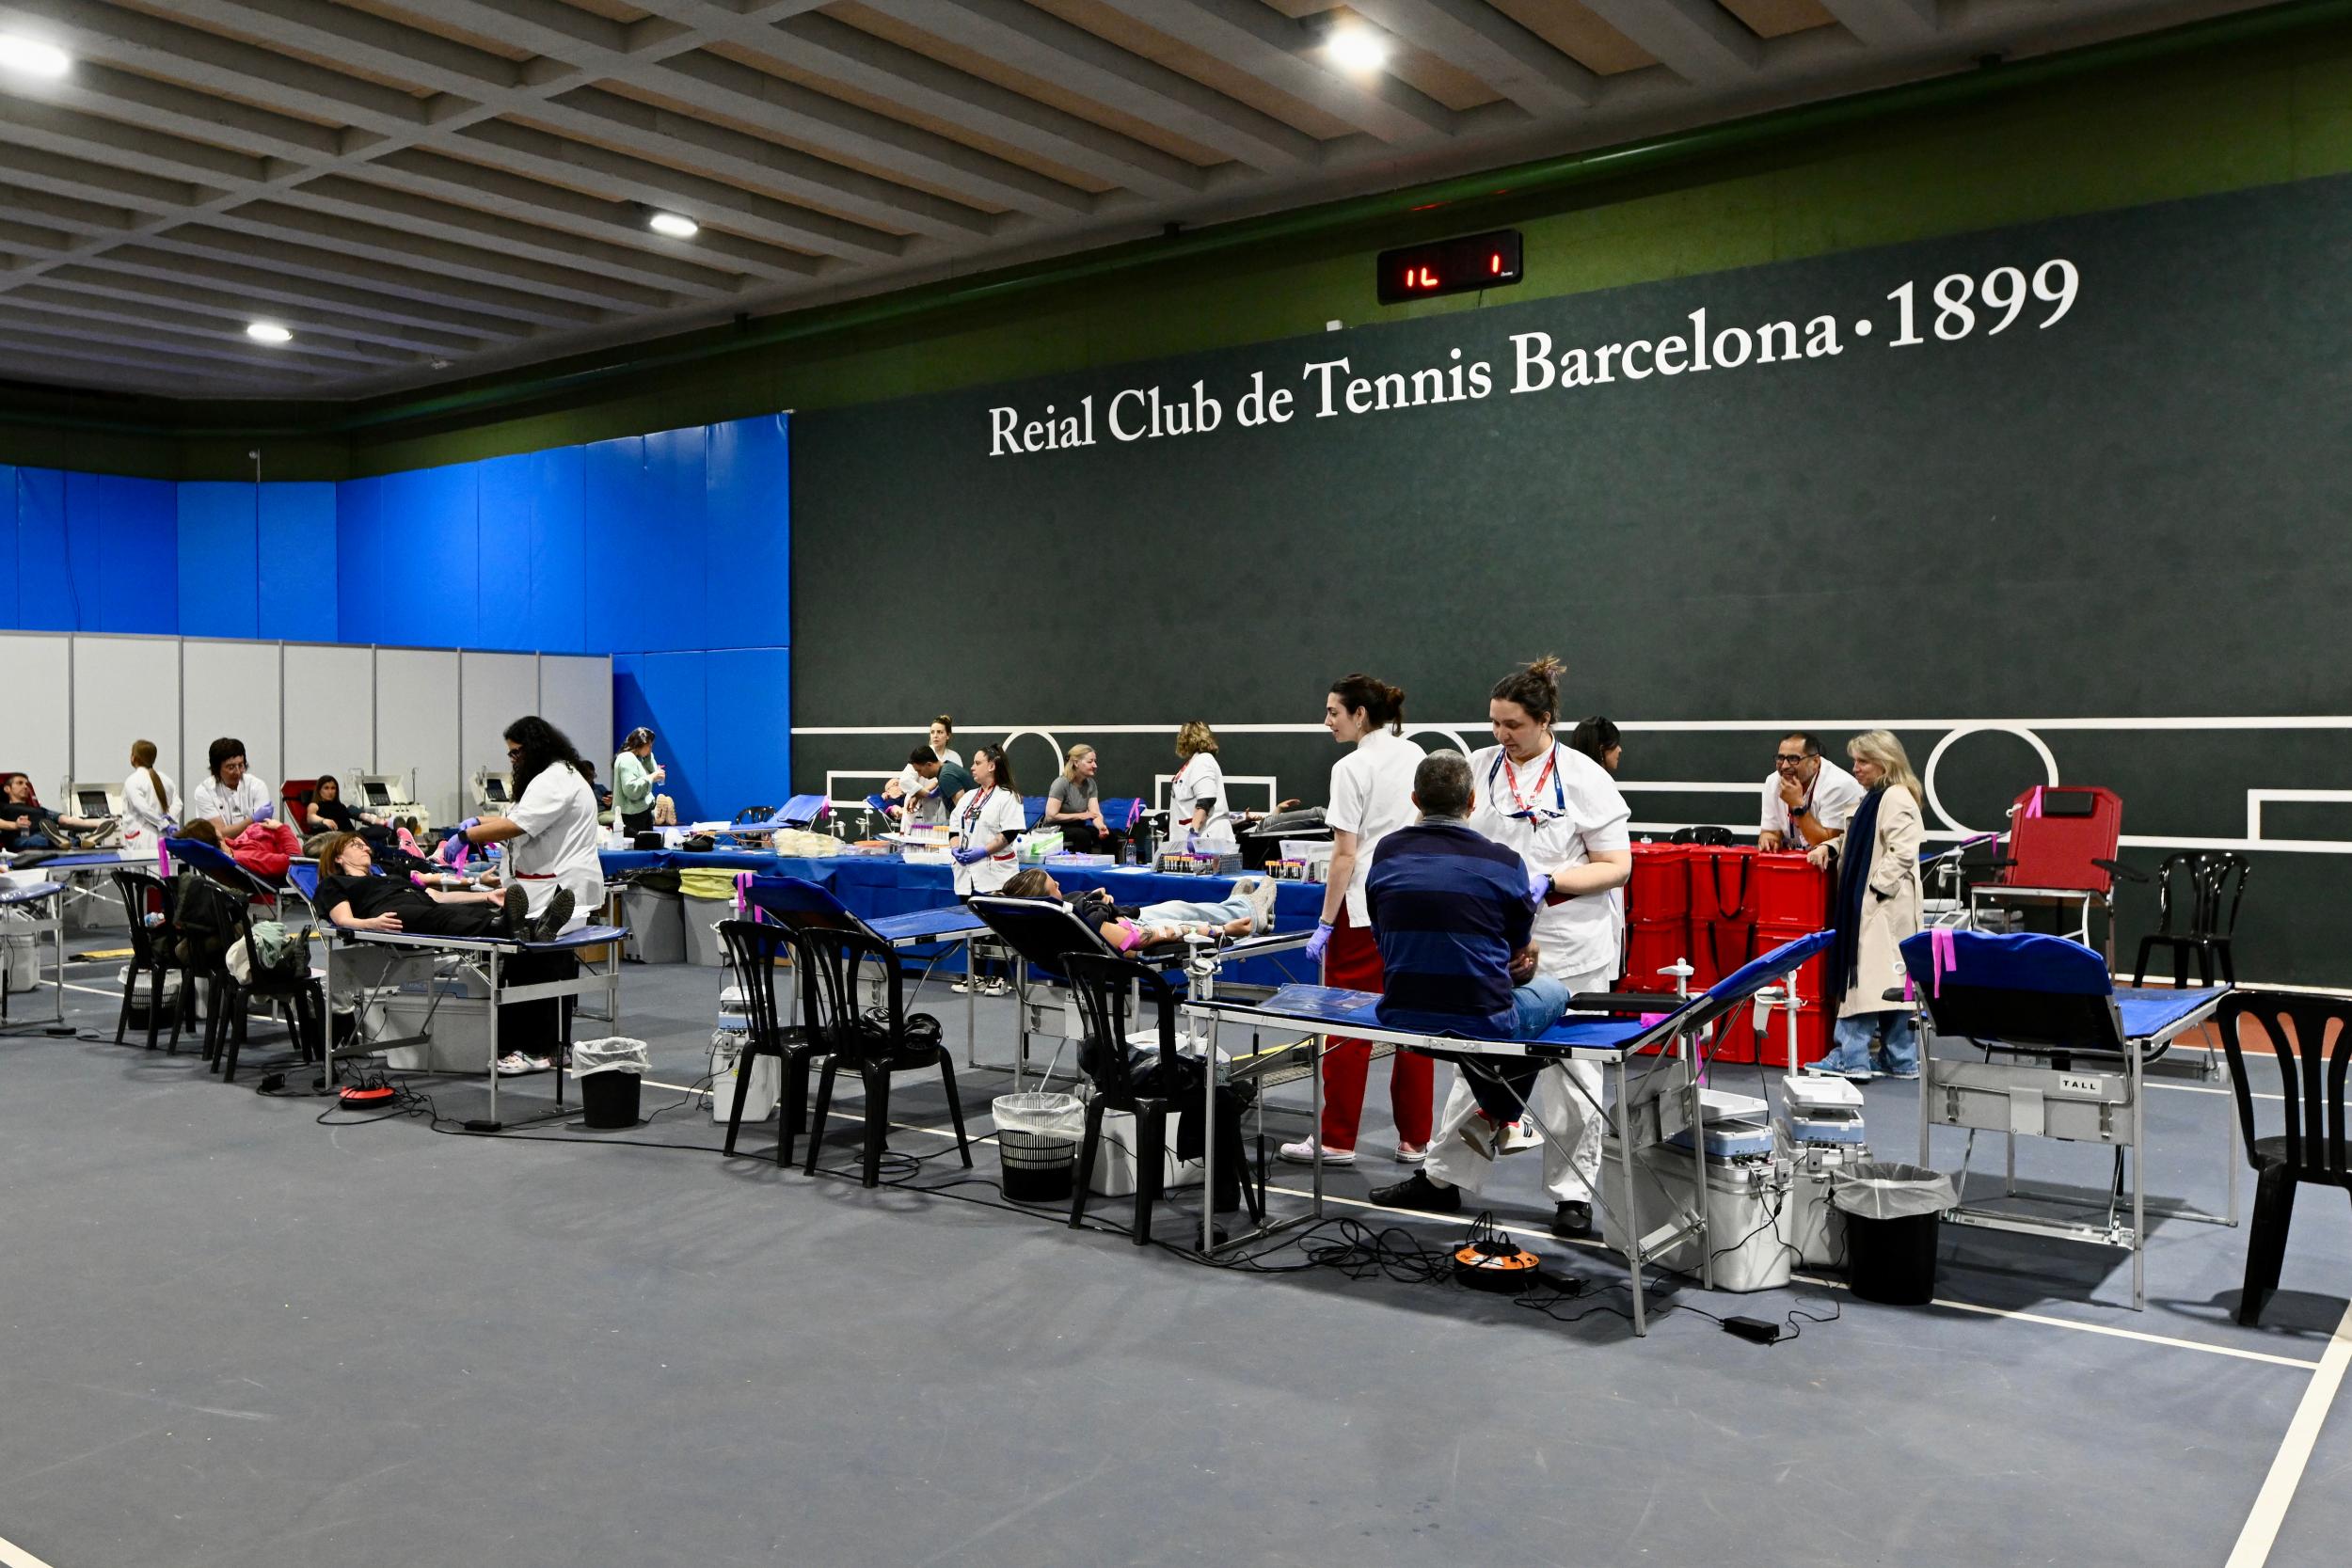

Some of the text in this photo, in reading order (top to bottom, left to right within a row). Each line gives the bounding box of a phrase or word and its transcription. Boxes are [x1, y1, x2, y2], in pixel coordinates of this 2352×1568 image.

[989, 259, 2079, 456] Reial Club de Tennis Barcelona 1899
[2062, 1080, 2097, 1090] TALL
